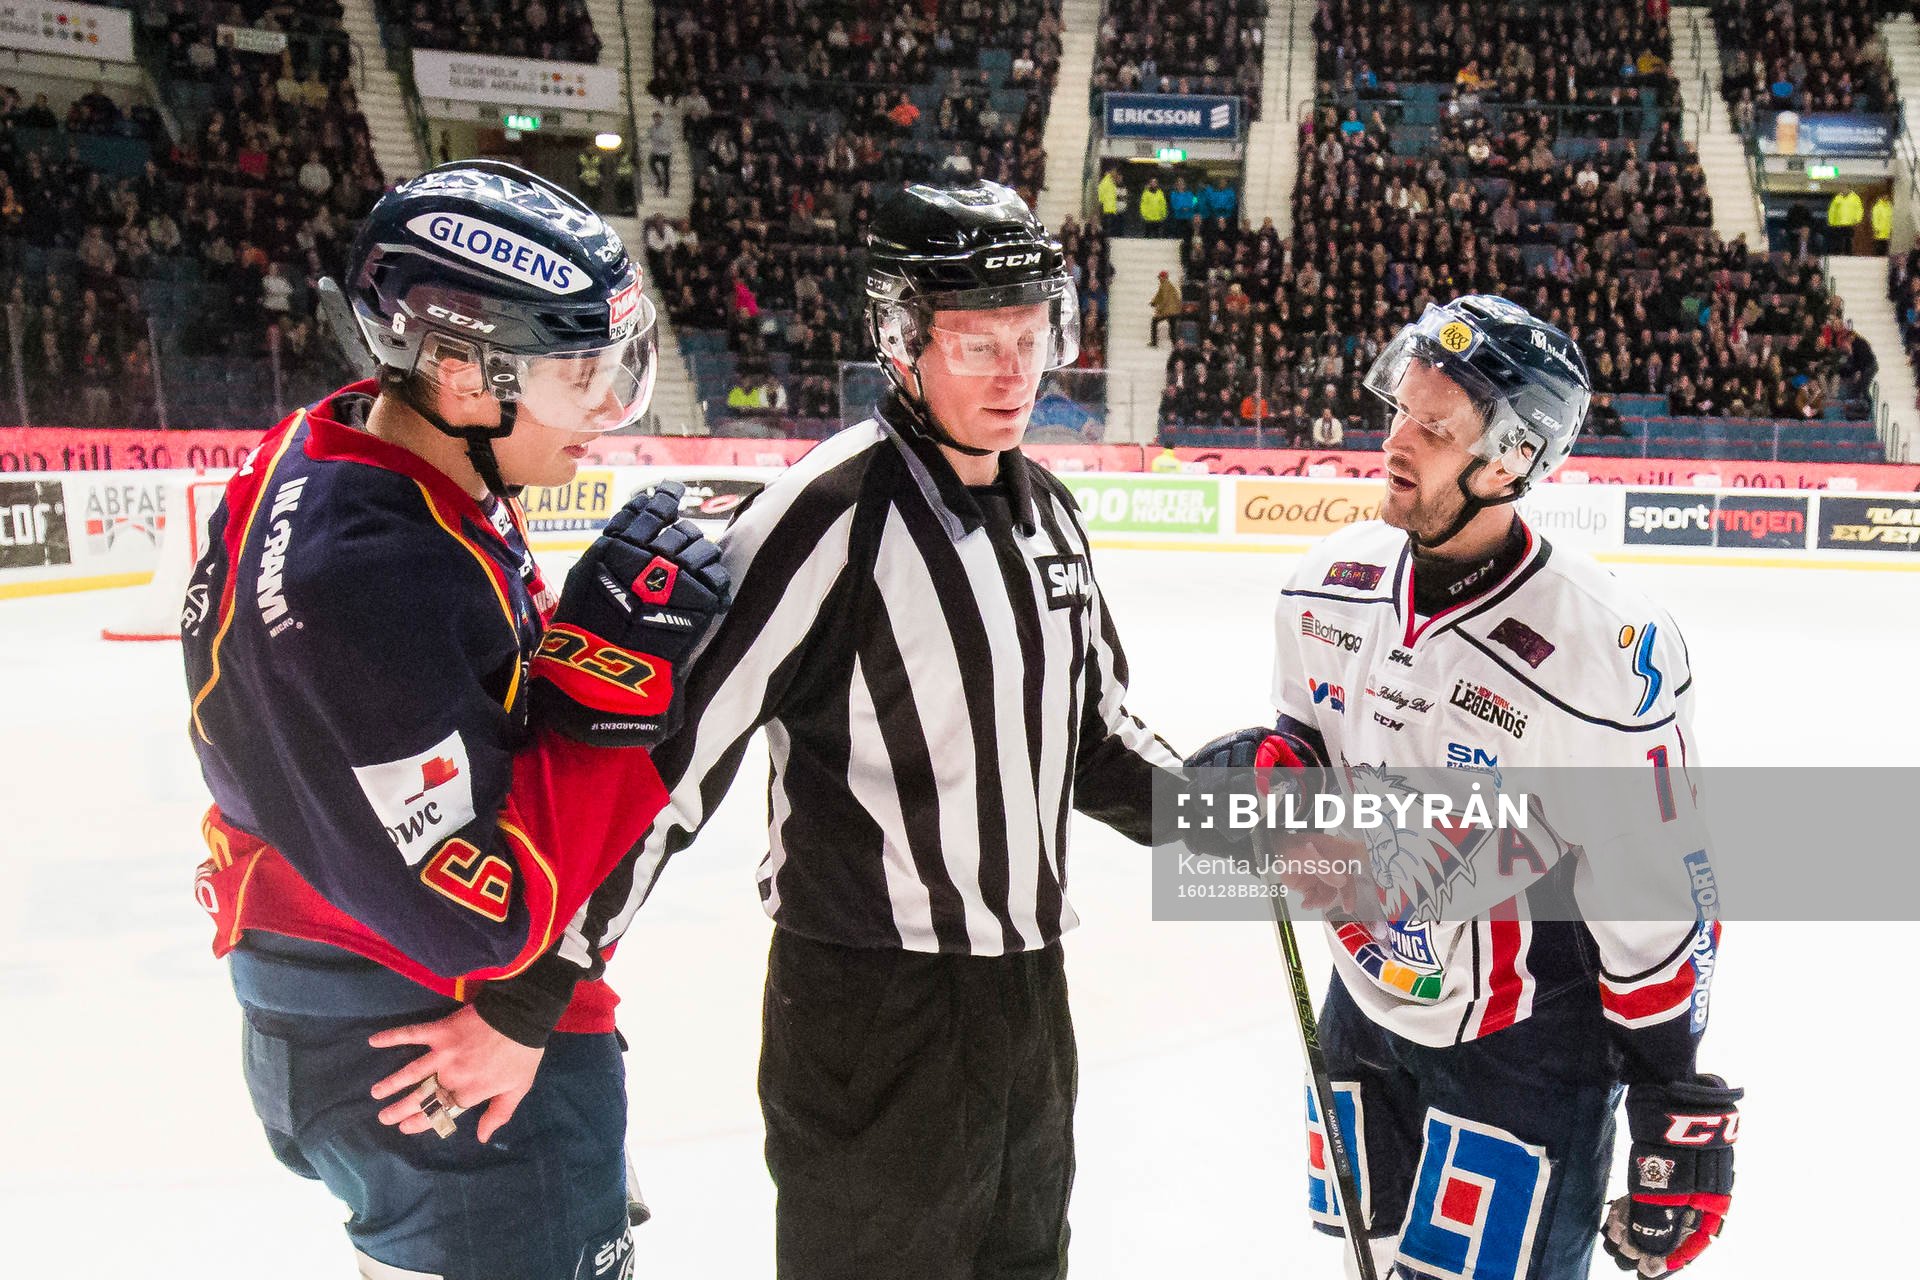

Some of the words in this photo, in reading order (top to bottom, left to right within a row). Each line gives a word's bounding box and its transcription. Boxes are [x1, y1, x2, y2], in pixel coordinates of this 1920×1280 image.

[1112, 108, 1202, 125] ERICSSON
[429, 215, 573, 289] GLOBENS
[985, 252, 1042, 269] CCM
[867, 276, 893, 292] CCM
[392, 312, 406, 335] 6
[427, 303, 497, 334] CCM
[1443, 325, 1469, 350] ägg
[1132, 488, 1205, 506] METER
[1131, 504, 1216, 524] HOCKEY
[1628, 504, 1805, 540] sportringen
[1448, 559, 1495, 596] CCM
[269, 616, 295, 638] MICRO
[1388, 649, 1414, 667] SHL
[1477, 686, 1493, 699] NEW
[1492, 693, 1511, 710] YORK
[1374, 711, 1404, 731] CCM
[1449, 684, 1527, 739] LEGENDS
[1447, 742, 1498, 768] SM
[1498, 818, 1549, 876] A
[420, 837, 513, 923] 6
